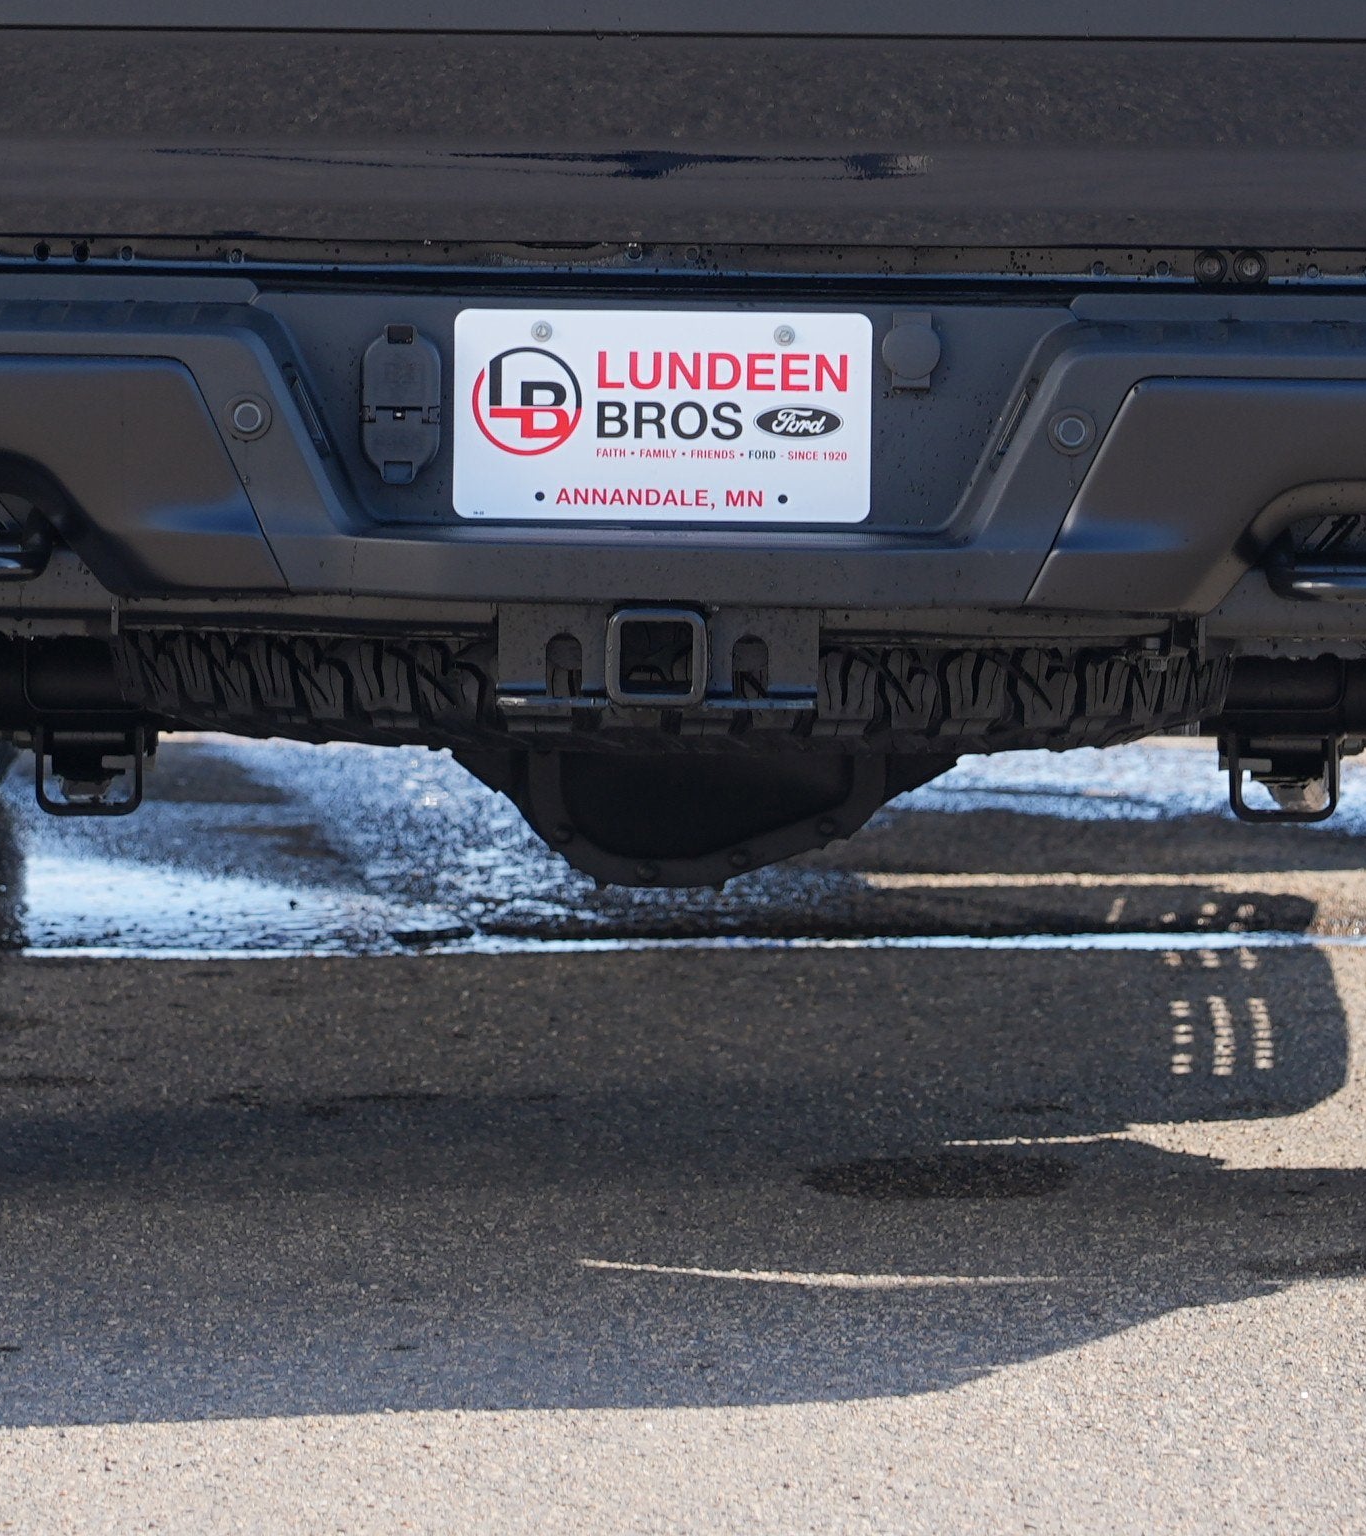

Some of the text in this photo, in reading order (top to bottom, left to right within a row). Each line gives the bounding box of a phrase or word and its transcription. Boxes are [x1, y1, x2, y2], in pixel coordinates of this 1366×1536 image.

[597, 350, 849, 393] LUNDEEN
[596, 401, 743, 441] BROS
[771, 408, 827, 434] Ford
[596, 448, 848, 461] FAITH FAMILY FRIENDS FORD SINCE 1920
[555, 487, 763, 510] ANNANDALE, MN
